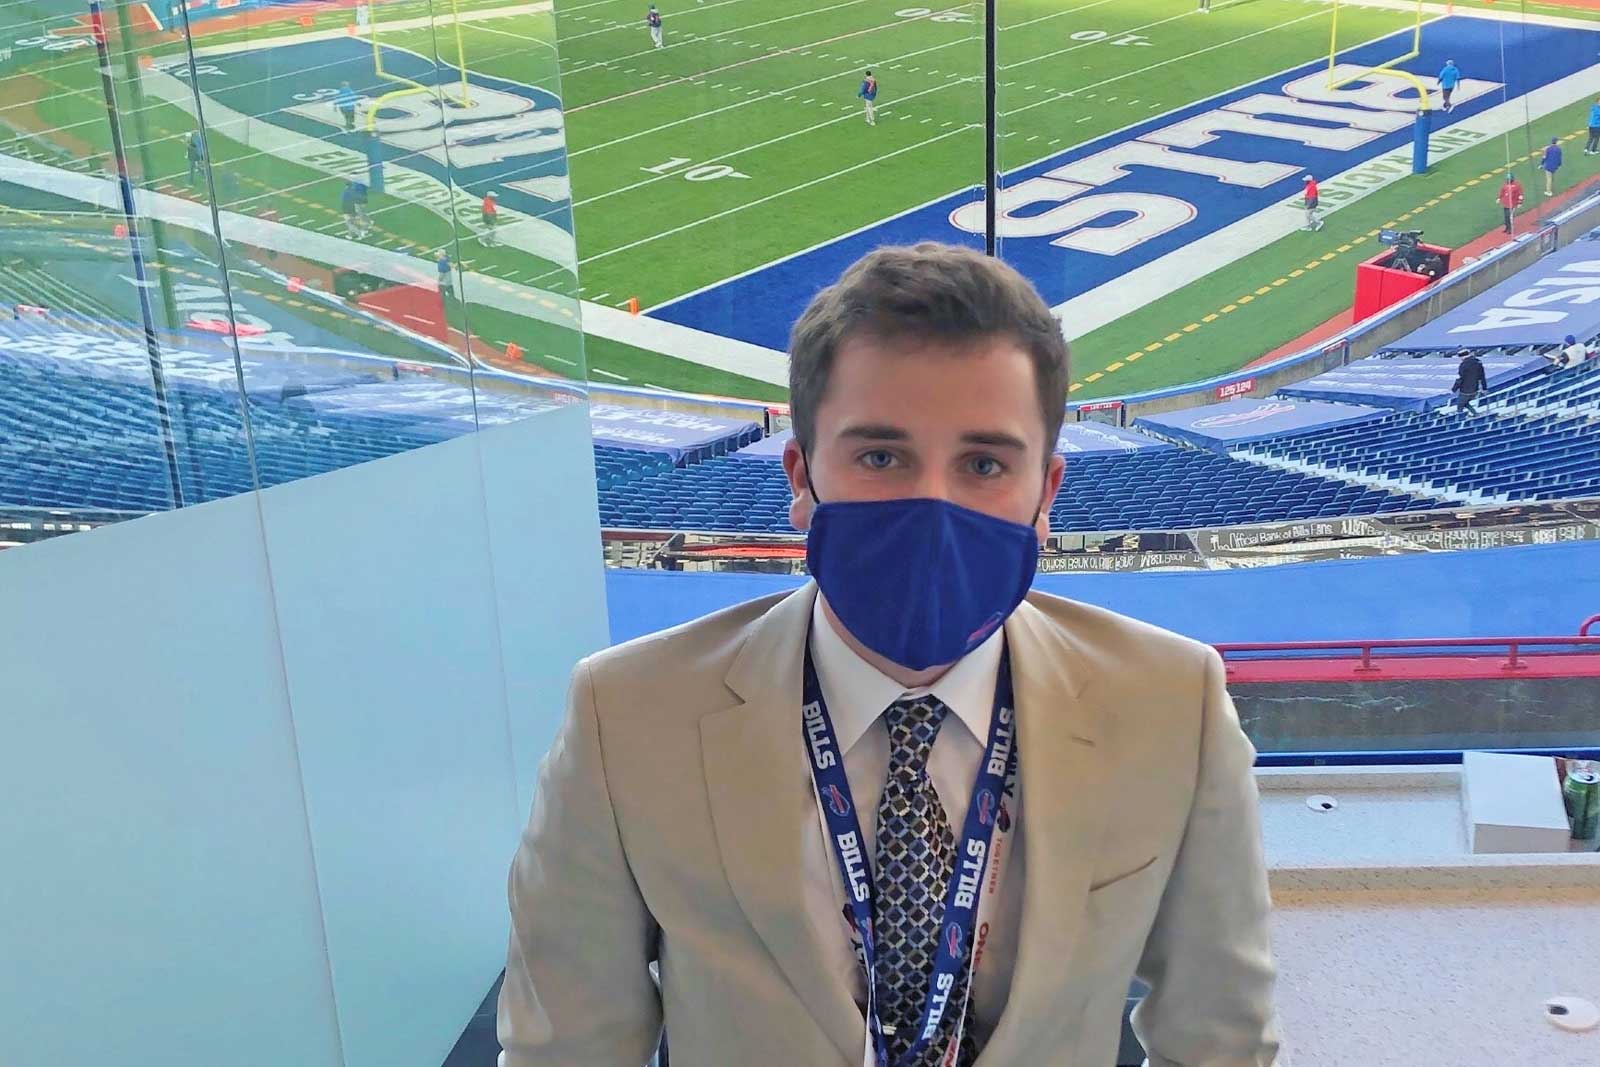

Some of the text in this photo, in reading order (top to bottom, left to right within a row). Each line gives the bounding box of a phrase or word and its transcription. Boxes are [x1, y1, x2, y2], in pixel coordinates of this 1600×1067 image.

[640, 156, 735, 181] 10
[949, 63, 1506, 256] BILLS
[1230, 532, 1259, 549] Official
[1260, 530, 1281, 542] Bank
[1281, 530, 1292, 539] of
[802, 700, 837, 770] BILLS
[986, 706, 1014, 777] BILLS
[837, 830, 871, 903] BILLS
[953, 838, 987, 910] BILLS
